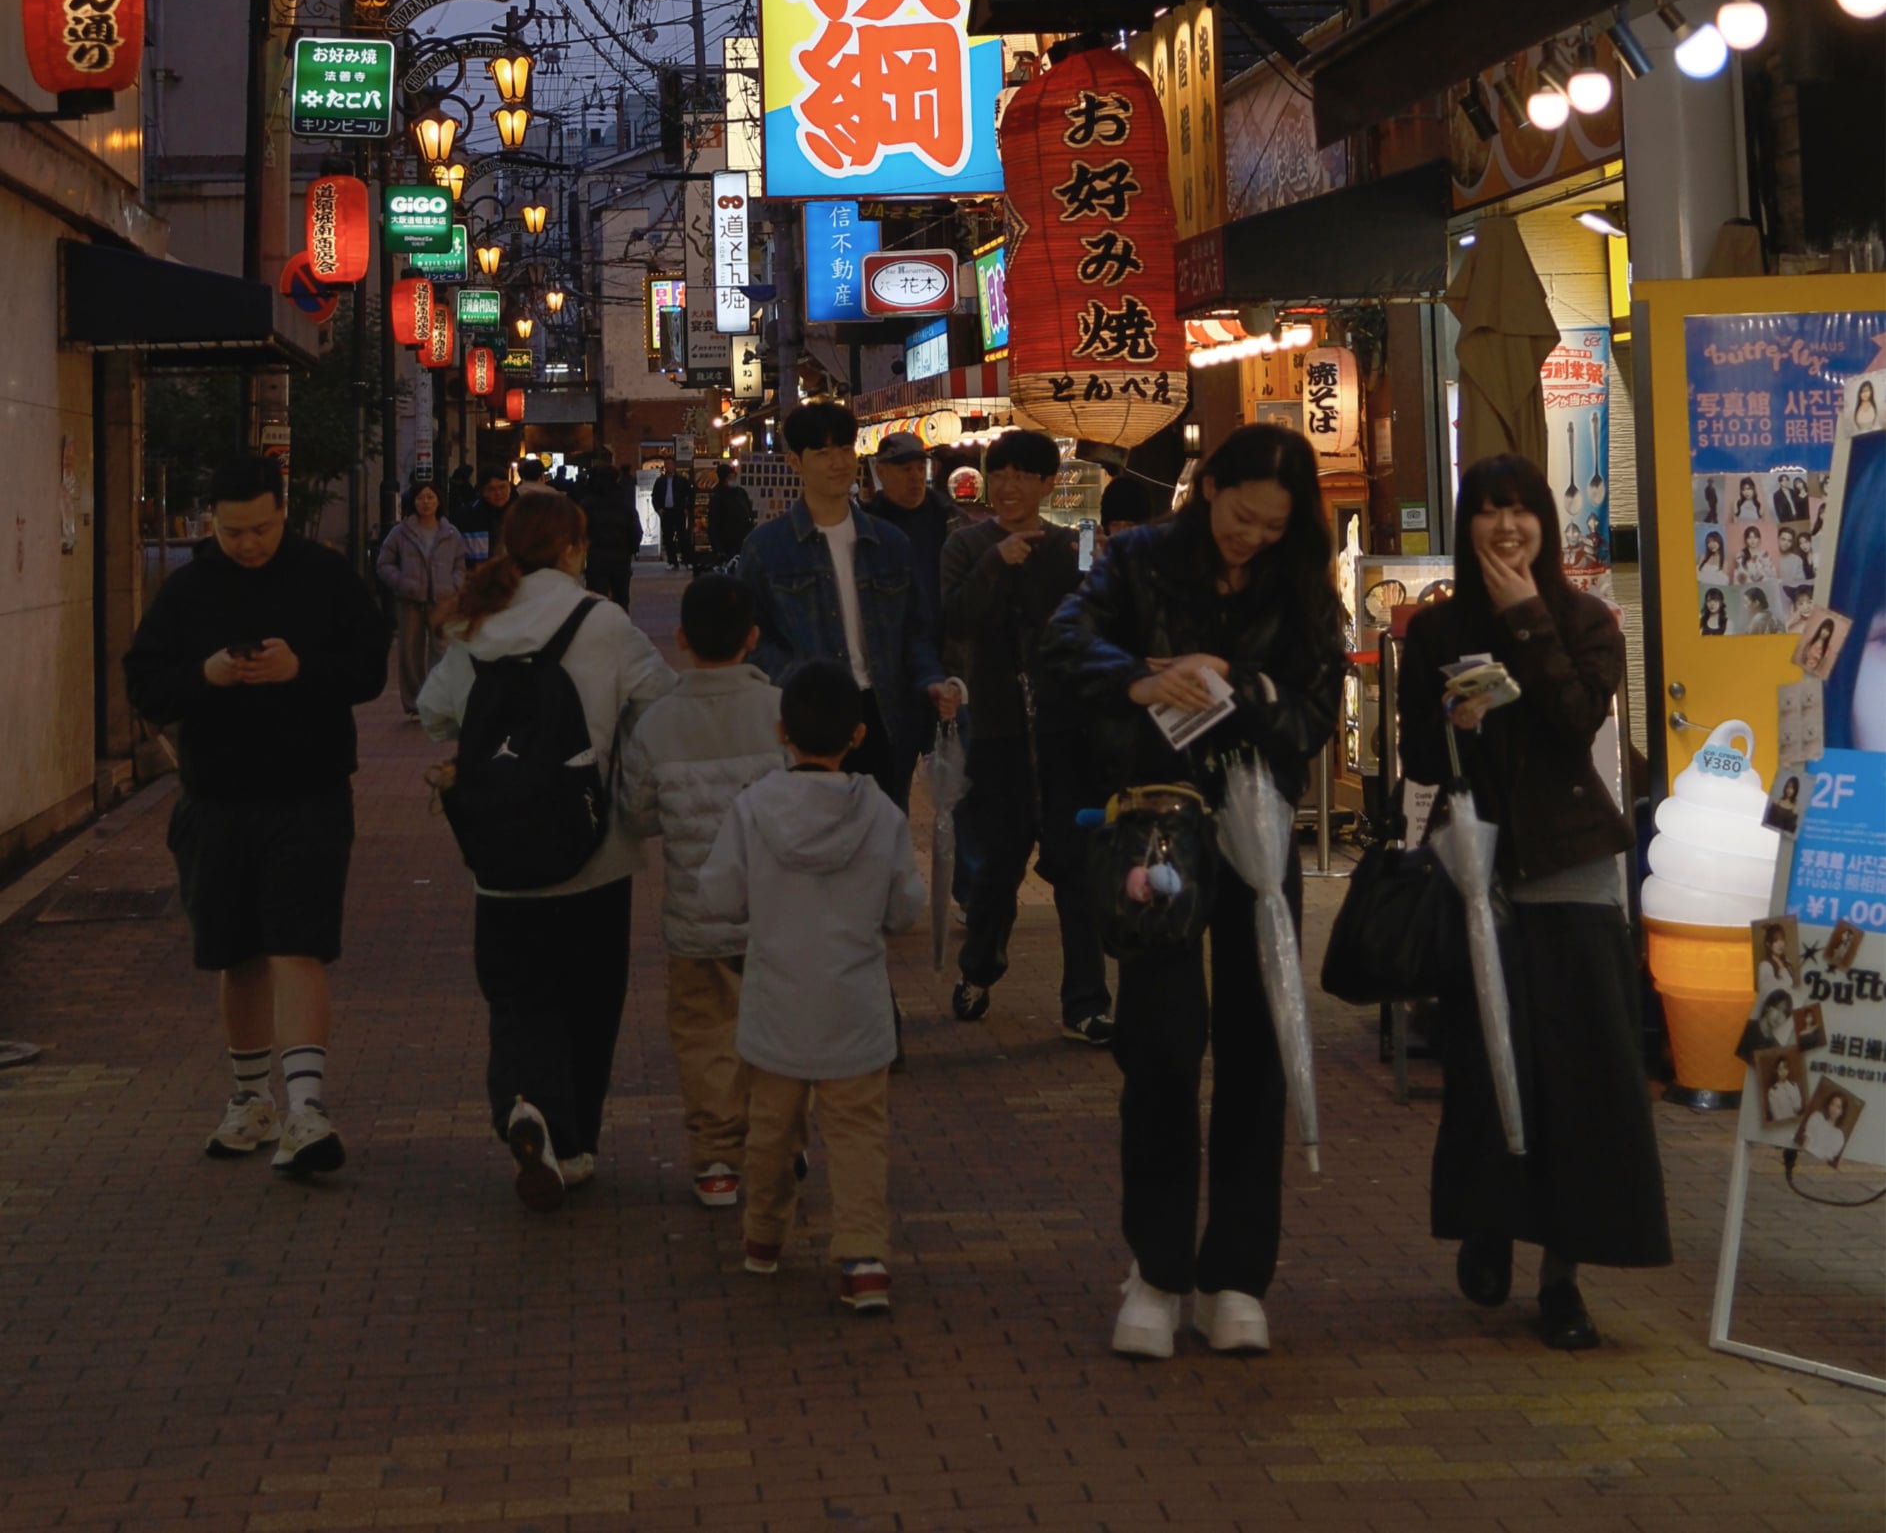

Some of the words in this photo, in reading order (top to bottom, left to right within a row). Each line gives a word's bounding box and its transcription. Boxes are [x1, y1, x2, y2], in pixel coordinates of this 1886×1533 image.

[312, 46, 378, 65] お好み焼
[301, 118, 382, 133] キリンビール
[390, 195, 448, 214] GiGO
[313, 183, 338, 275] 道頓堀南商店会
[1053, 92, 1158, 362] お好み焼
[719, 214, 746, 310] 道とん堀
[829, 205, 854, 308] 信不動産
[424, 273, 462, 281] リンビール
[1306, 361, 1339, 435] 焼そば
[1696, 391, 1771, 418] 写真館
[1697, 418, 1772, 432] PHOTO
[1698, 433, 1772, 448] STUDIO
[1703, 755, 1742, 773] ¥380
[1811, 773, 1856, 809] 2F
[1804, 968, 1886, 1005] butt
[1829, 1033, 1886, 1062] 当日撮
